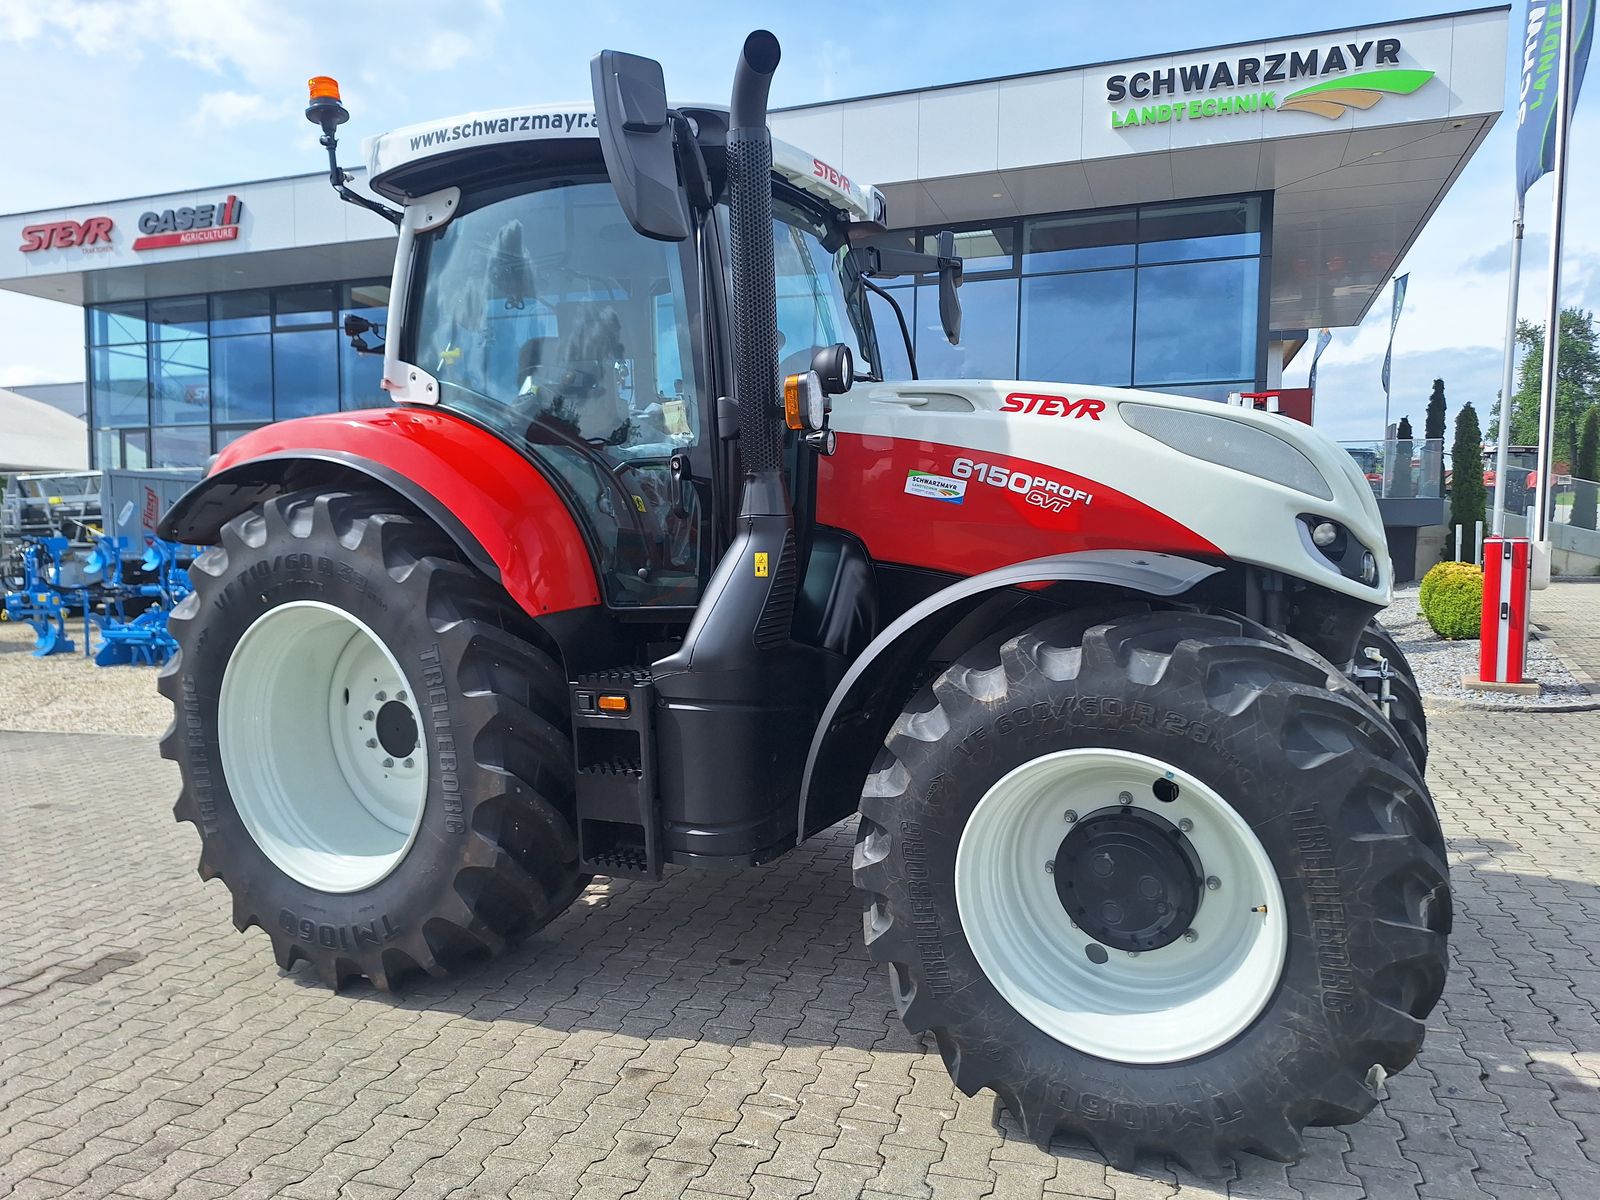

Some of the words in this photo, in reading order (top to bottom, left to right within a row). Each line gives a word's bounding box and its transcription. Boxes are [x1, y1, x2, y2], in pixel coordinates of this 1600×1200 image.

[1106, 38, 1402, 102] SCHWARZMAYR
[1517, 0, 1546, 130] SCHW
[1111, 90, 1277, 129] LANDTECHNIK
[812, 158, 852, 193] STEYR
[19, 216, 113, 252] STEYR
[138, 204, 215, 234] CASE
[180, 228, 233, 243] AGRICULTURE
[999, 393, 1106, 420] STEYR
[912, 476, 958, 491] SCHWARZMAYR
[952, 457, 1032, 495] 6150
[1031, 477, 1093, 505] PROFI
[1025, 490, 1071, 513] CVT
[418, 642, 466, 835] TRELLEBORG
[901, 820, 954, 999] TRELLEBORG
[1288, 801, 1354, 1014] TRELLEBORG
[278, 906, 402, 952] TM1060
